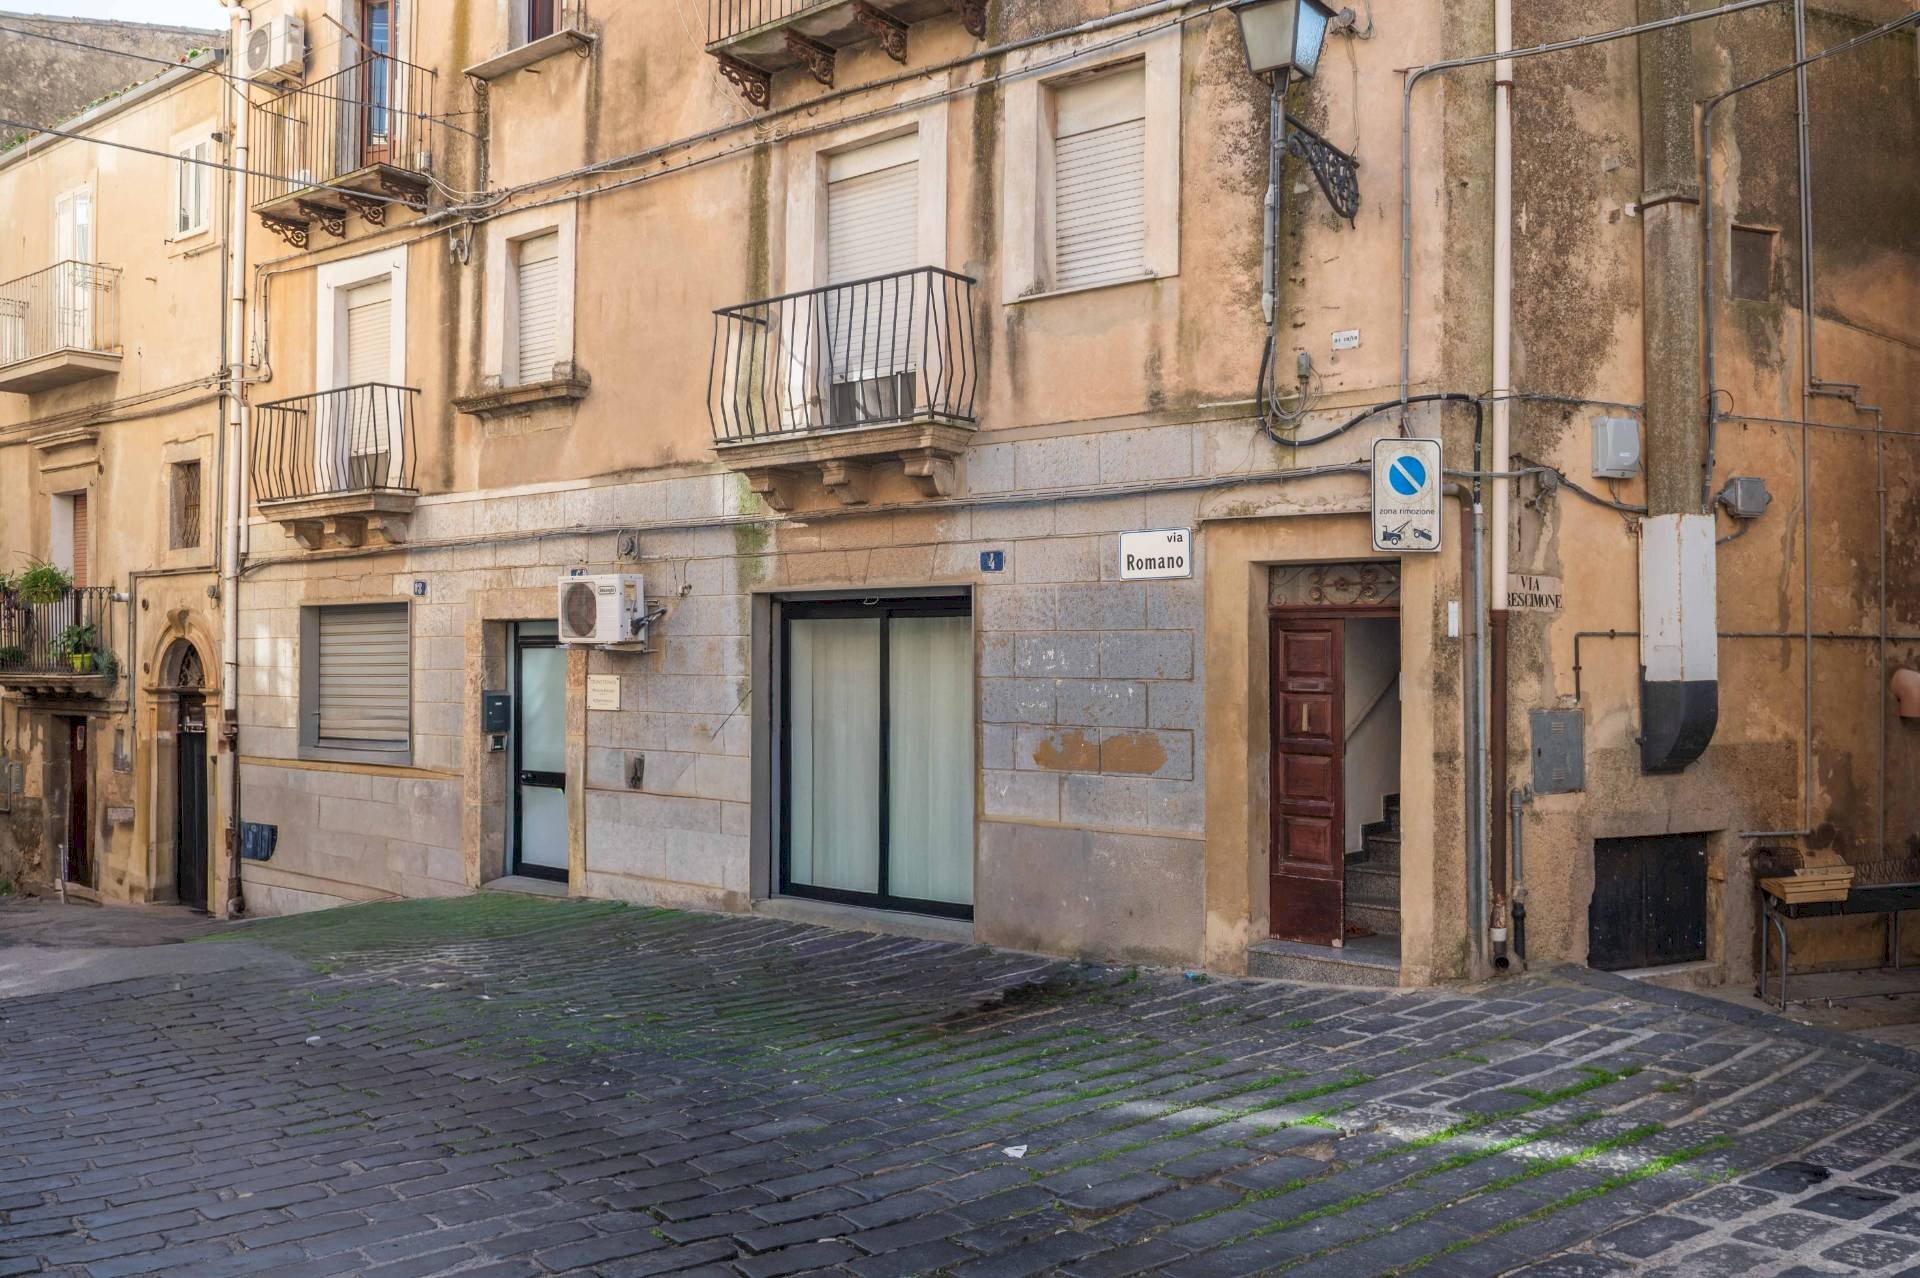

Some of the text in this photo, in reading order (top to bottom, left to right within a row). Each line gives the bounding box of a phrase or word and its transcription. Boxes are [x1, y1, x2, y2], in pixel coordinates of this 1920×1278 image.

[1399, 507, 1435, 515] rimozione
[1166, 531, 1183, 543] via
[1127, 554, 1184, 571] Romano
[1520, 575, 1540, 591] VIA
